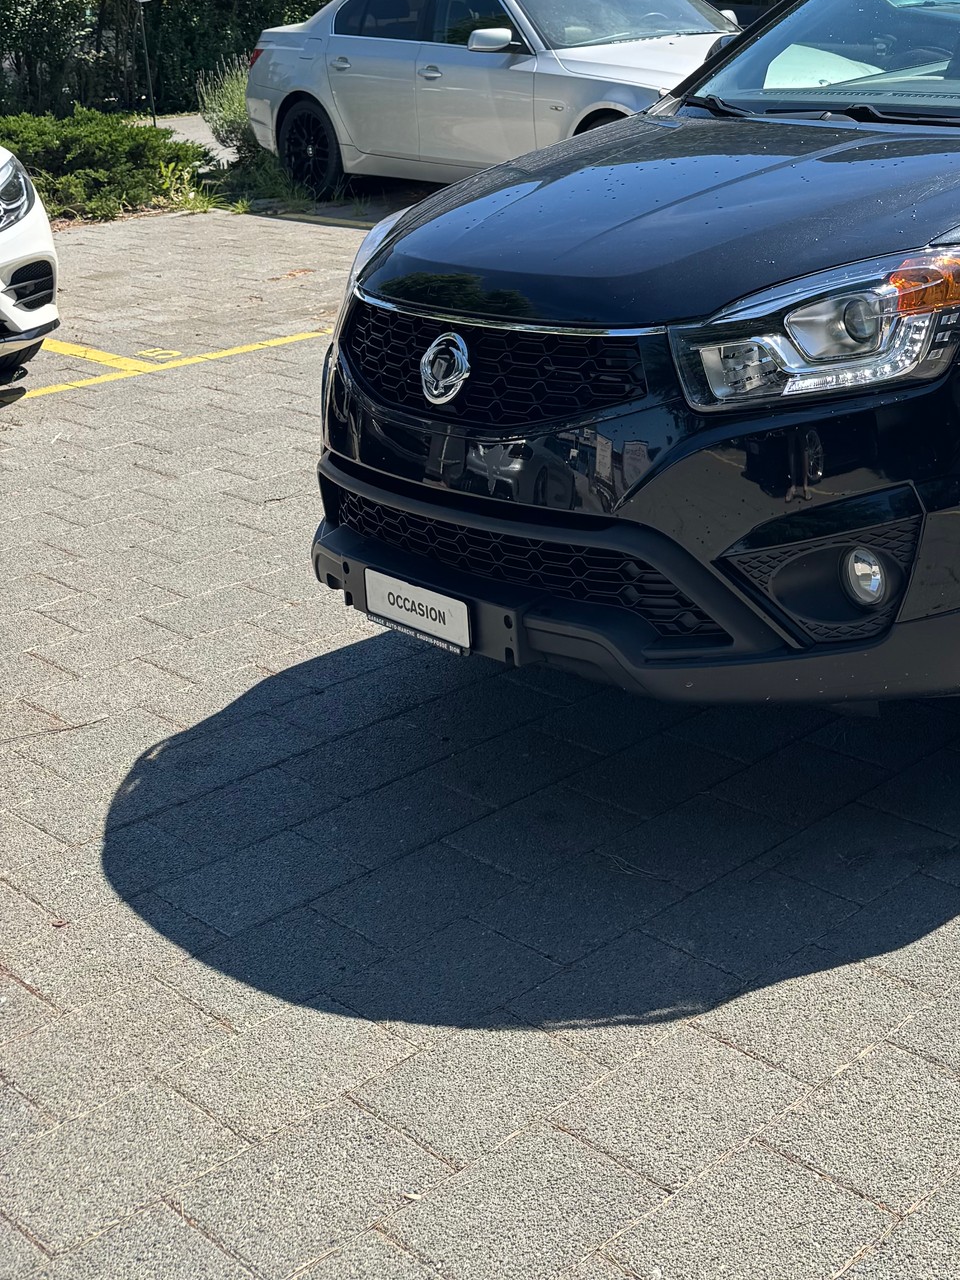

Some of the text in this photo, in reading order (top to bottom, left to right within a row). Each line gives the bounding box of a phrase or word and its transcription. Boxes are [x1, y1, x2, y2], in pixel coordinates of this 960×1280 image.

[387, 591, 447, 626] OCCASION
[367, 614, 385, 625] GARAGE
[449, 645, 461, 654] SION
